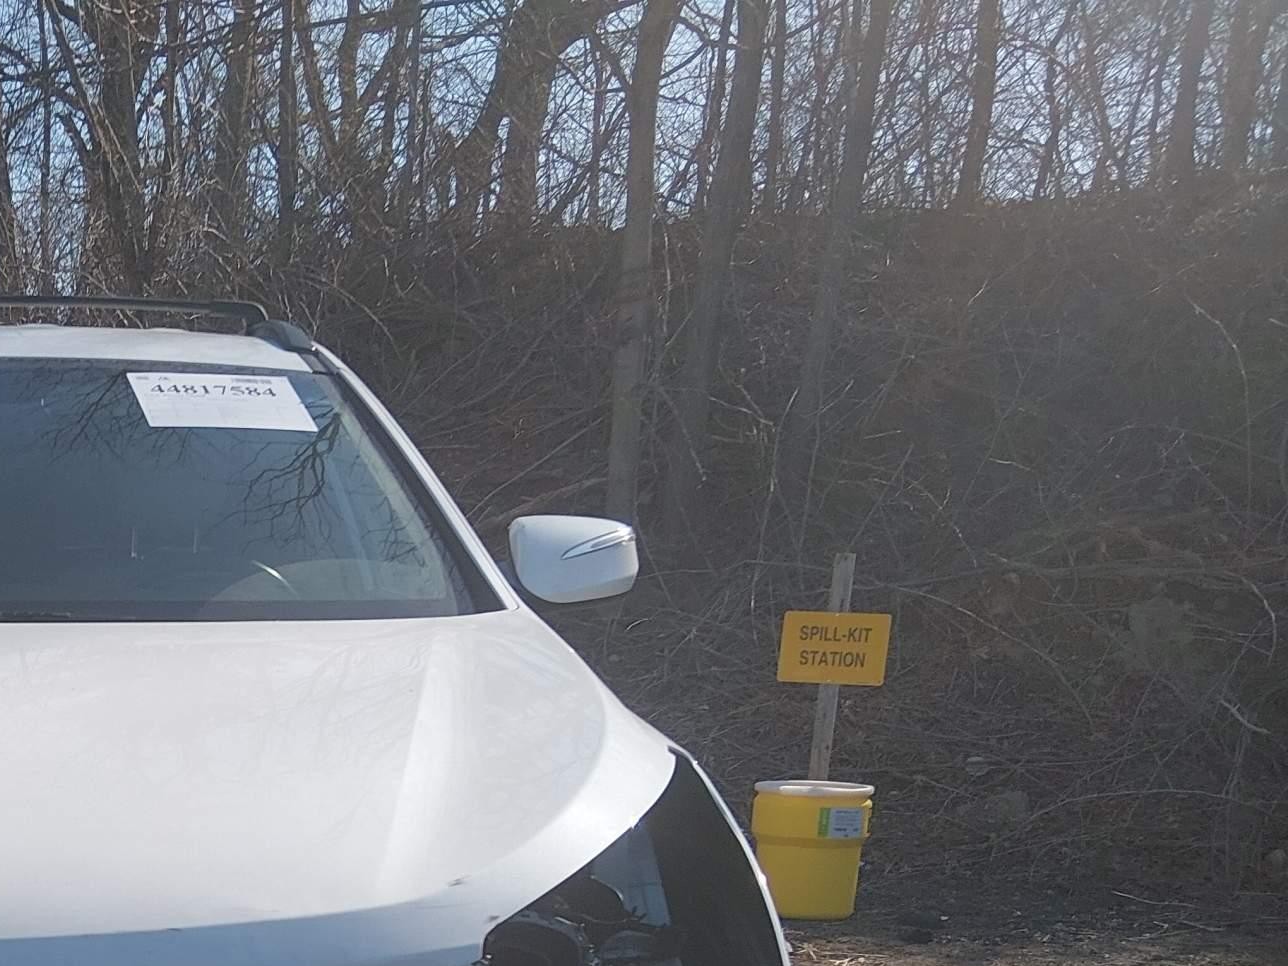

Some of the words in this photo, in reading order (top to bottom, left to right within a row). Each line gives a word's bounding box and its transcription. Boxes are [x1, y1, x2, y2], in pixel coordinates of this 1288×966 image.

[150, 384, 277, 397] 44817584
[799, 625, 872, 642] SPILL-KIT
[799, 650, 866, 667] STATION
